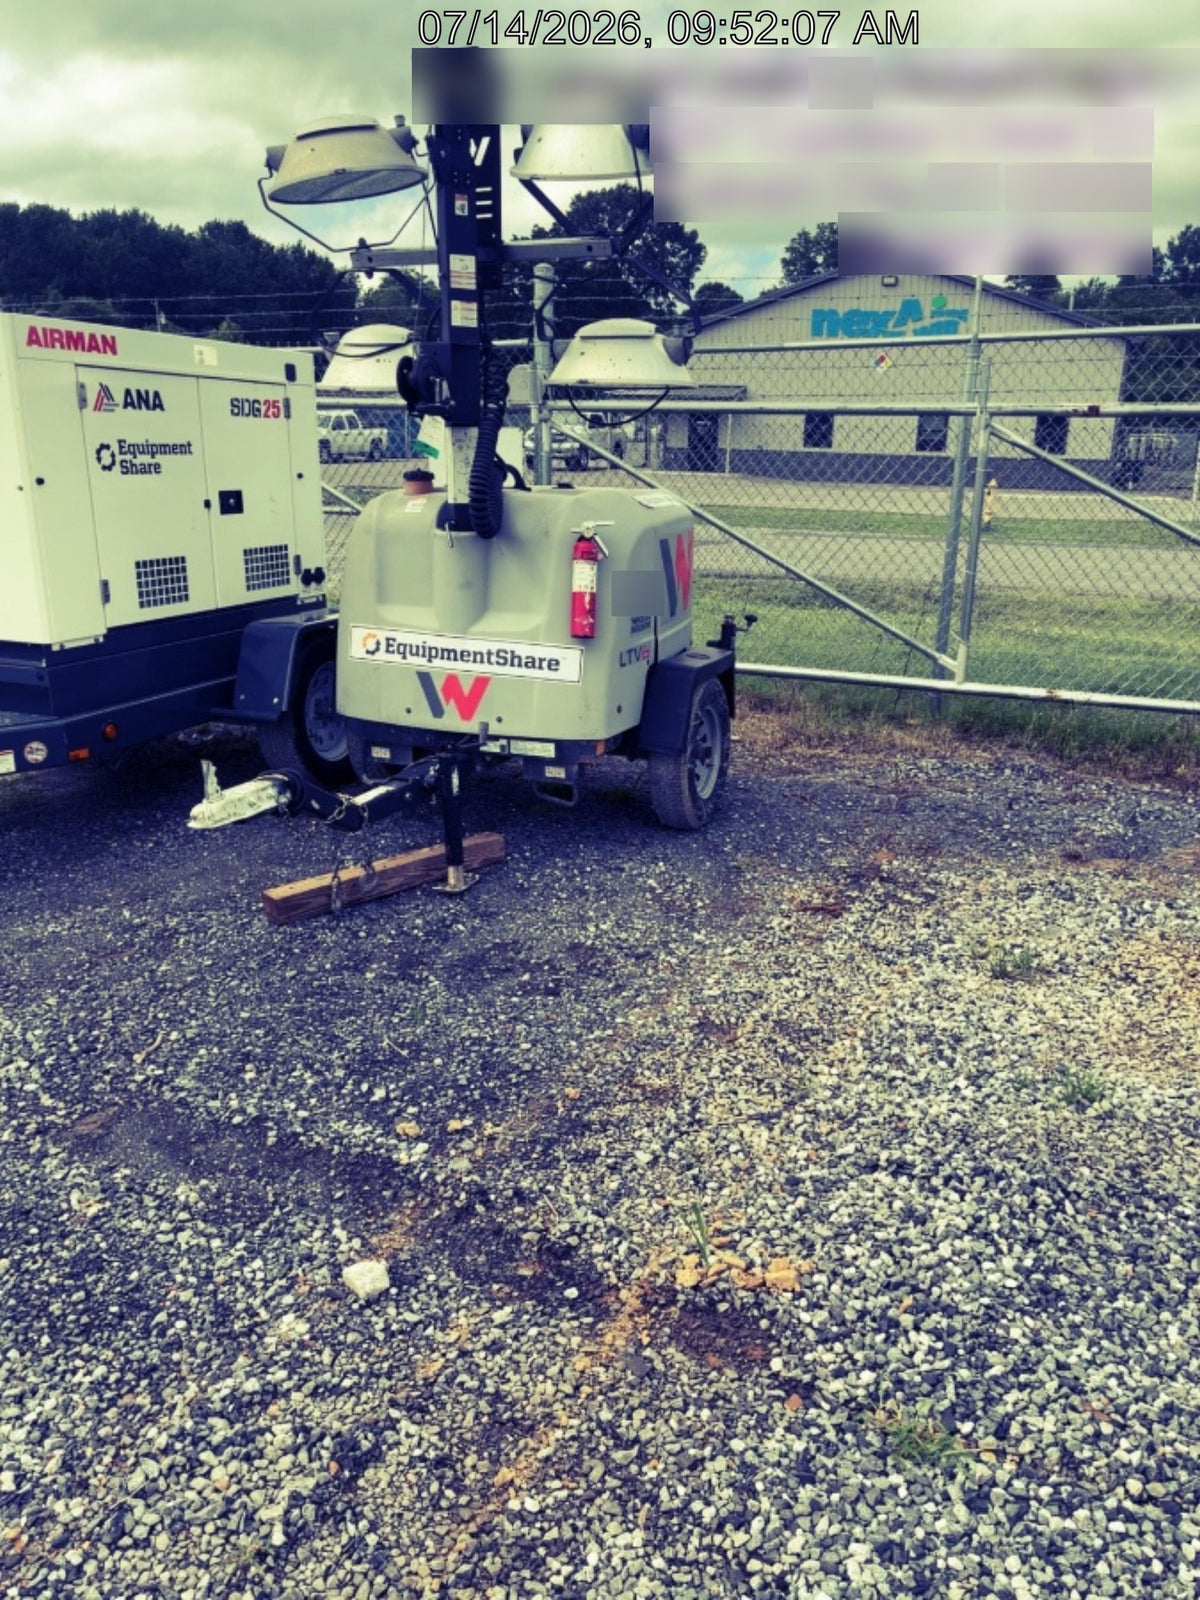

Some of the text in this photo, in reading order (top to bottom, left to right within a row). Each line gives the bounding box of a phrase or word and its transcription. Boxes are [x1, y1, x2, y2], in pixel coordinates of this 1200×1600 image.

[811, 296, 969, 338] nexAir
[26, 325, 118, 356] AIRMAN
[122, 388, 165, 412] ANA
[230, 396, 281, 419] SDG25
[117, 439, 193, 459] Equipment
[119, 460, 162, 475] Share
[384, 637, 560, 672] EquipmentShare
